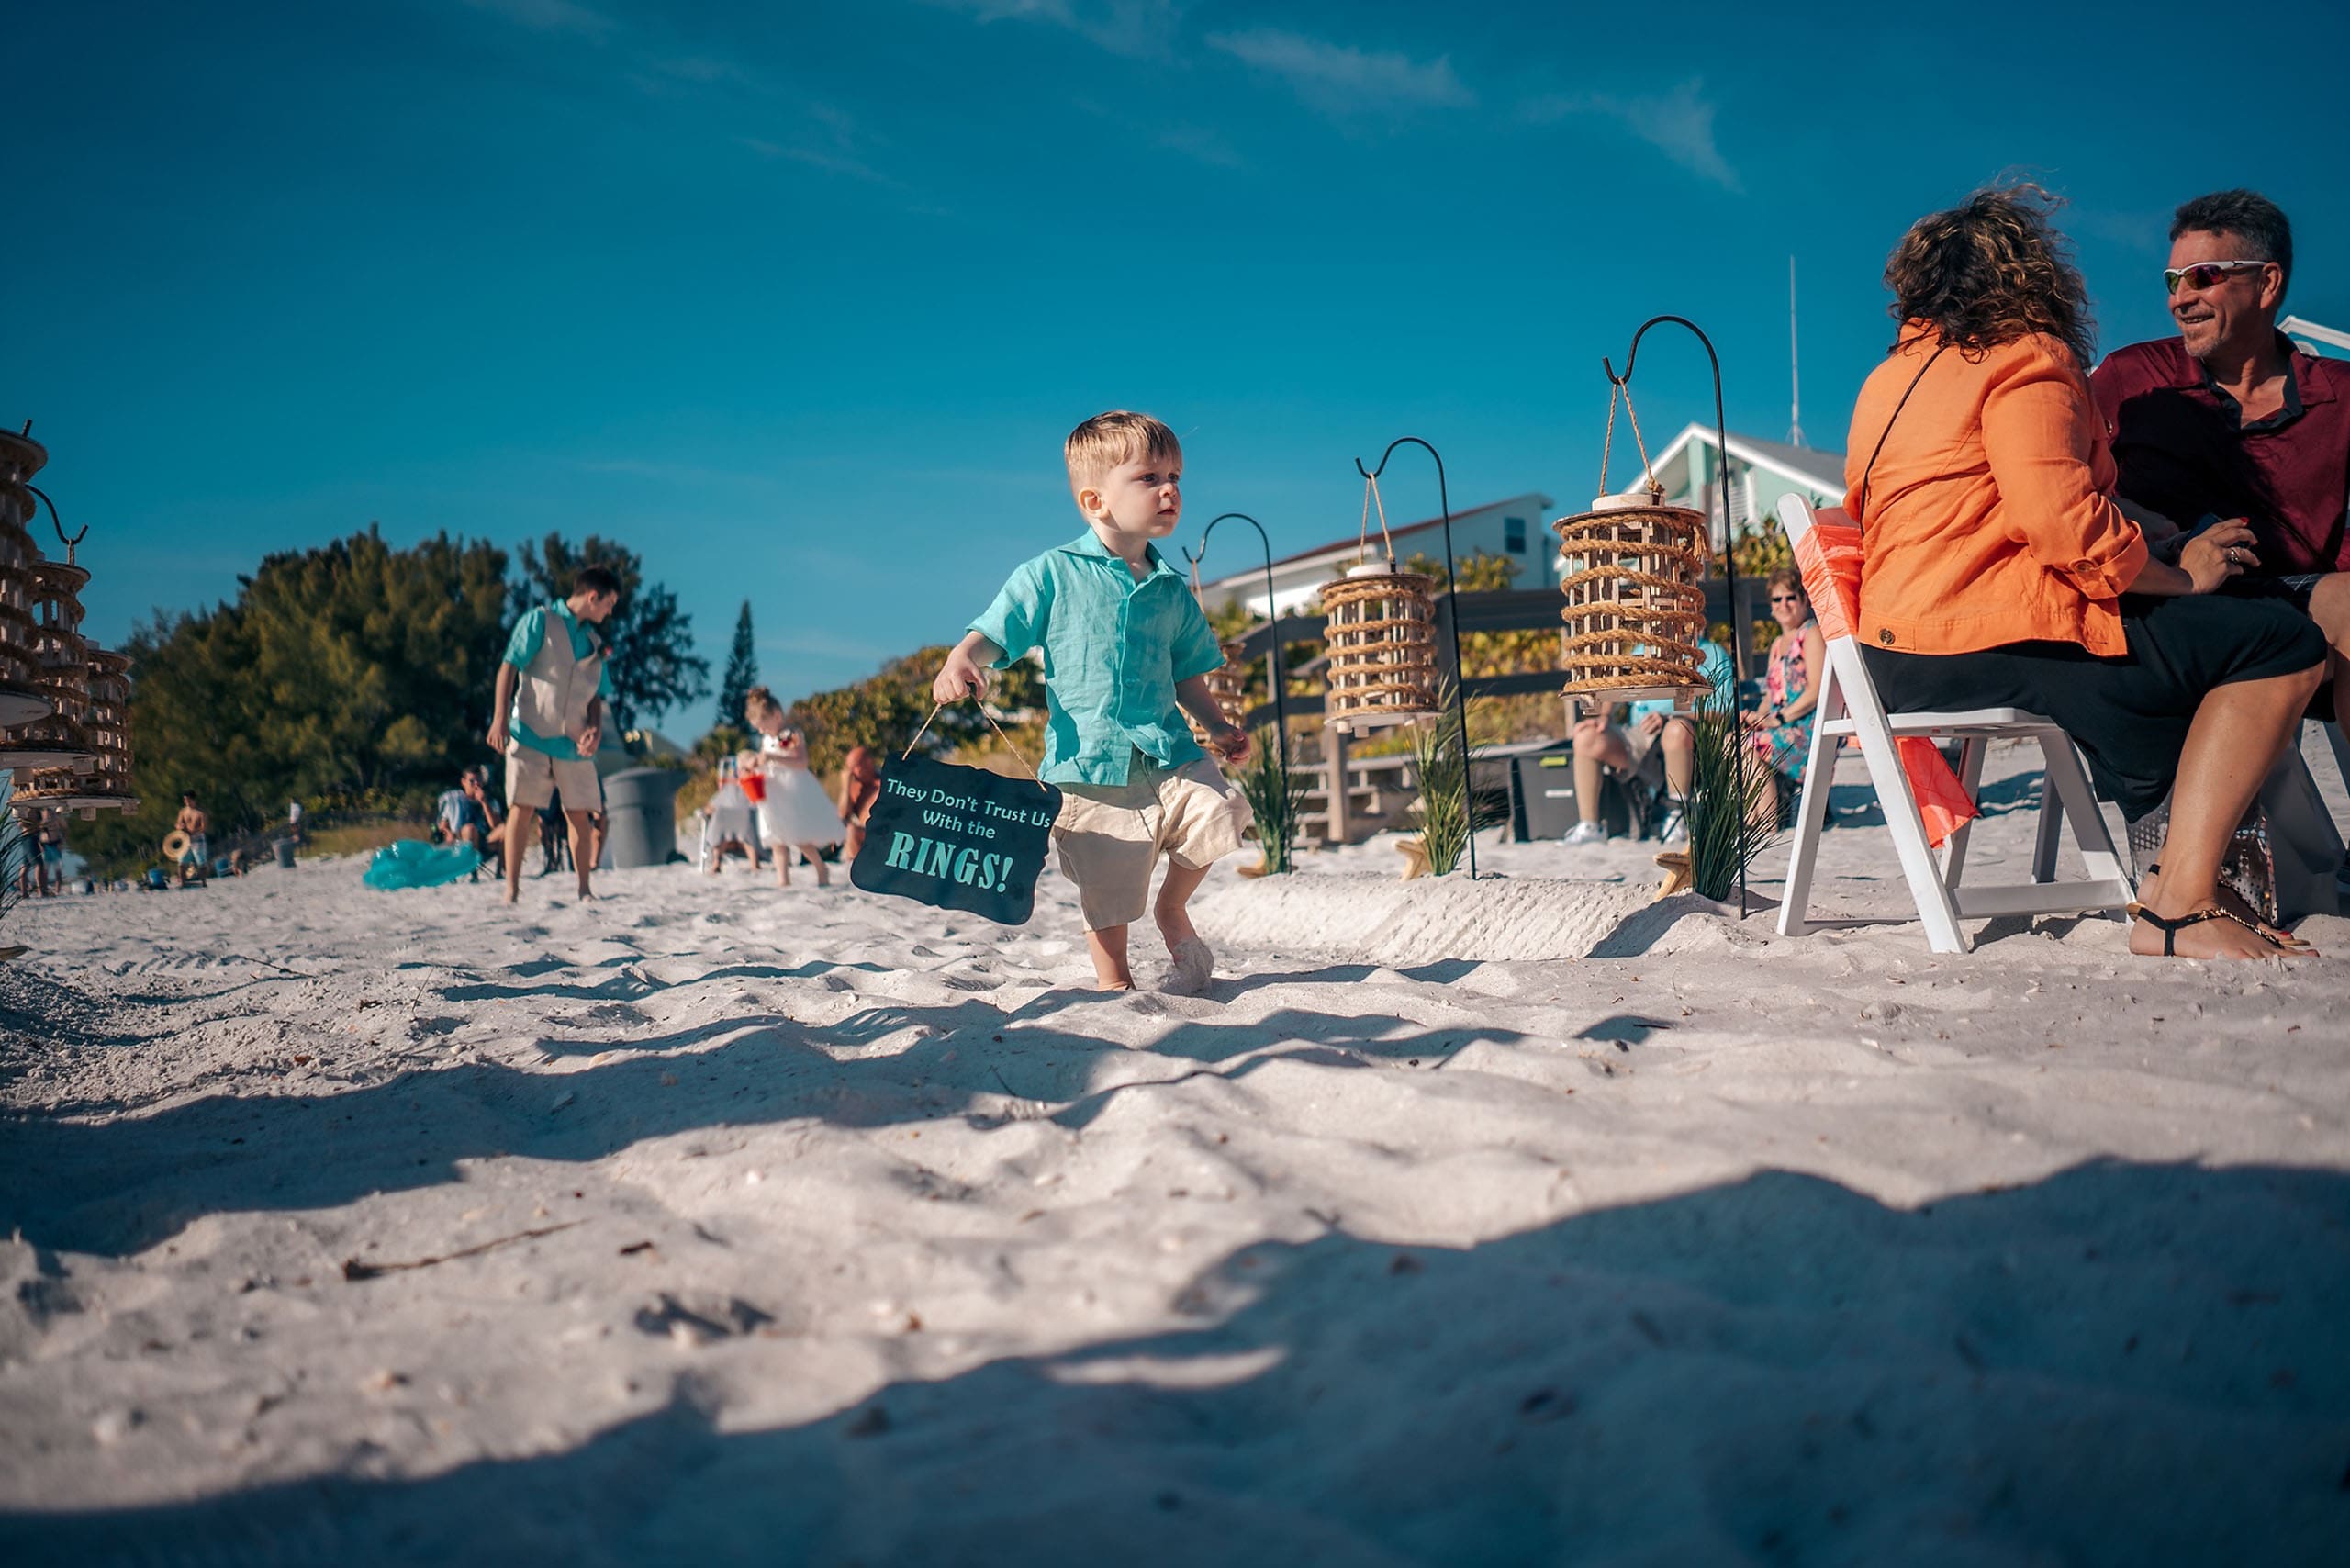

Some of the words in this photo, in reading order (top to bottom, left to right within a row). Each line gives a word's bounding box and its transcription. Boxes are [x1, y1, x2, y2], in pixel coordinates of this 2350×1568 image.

[887, 778, 927, 802] They
[930, 789, 979, 812] Don't
[984, 800, 1027, 823] Trust
[1031, 811, 1051, 828] Us
[923, 809, 962, 832] With
[968, 820, 996, 839] the
[884, 831, 1013, 893] RINGS!
